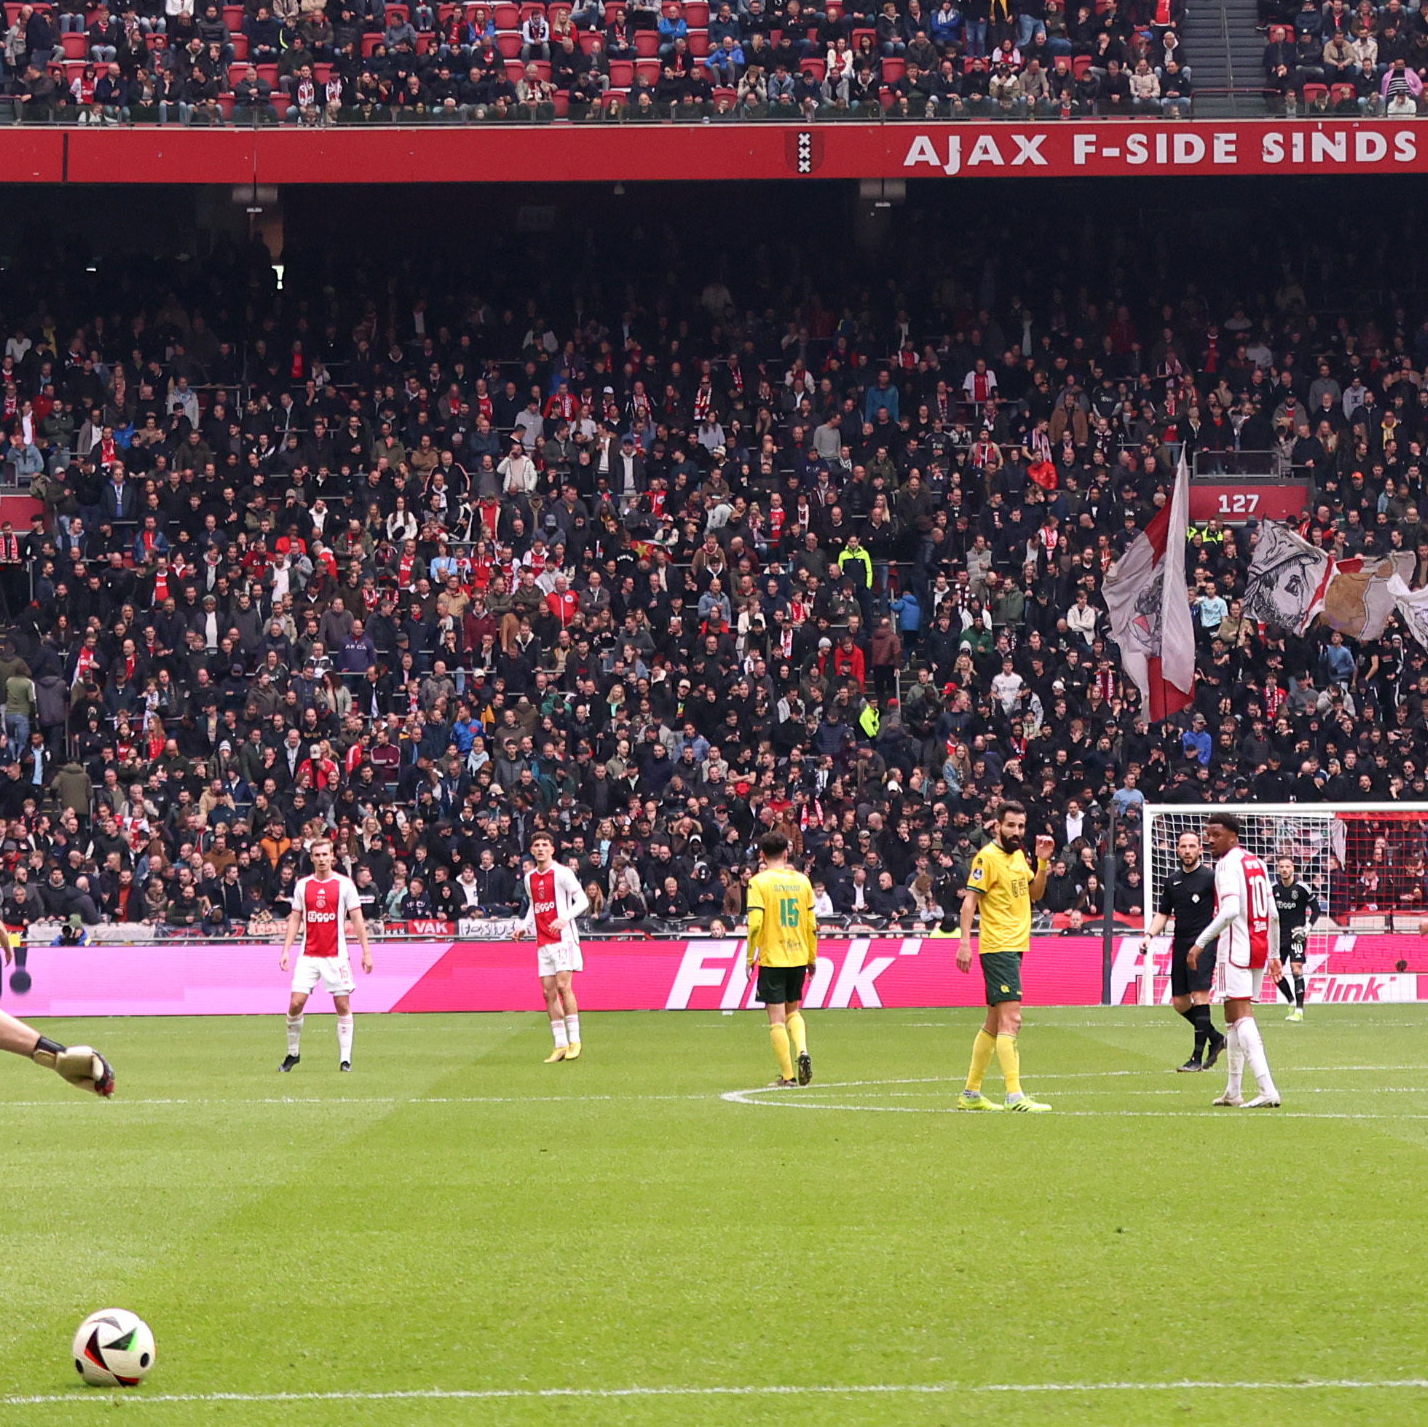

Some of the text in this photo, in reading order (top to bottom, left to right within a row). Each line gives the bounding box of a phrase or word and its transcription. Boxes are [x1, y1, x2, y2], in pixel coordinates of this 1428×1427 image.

[903, 134, 1048, 175] AJAX
[1073, 133, 1237, 164] F-SIDE
[1262, 131, 1417, 163] SINDS
[1218, 494, 1260, 513] 127
[1249, 875, 1268, 919] 10
[780, 898, 799, 928] 15
[413, 922, 448, 934] VAK
[1291, 943, 1303, 954] 40
[1304, 976, 1385, 1003] Flink
